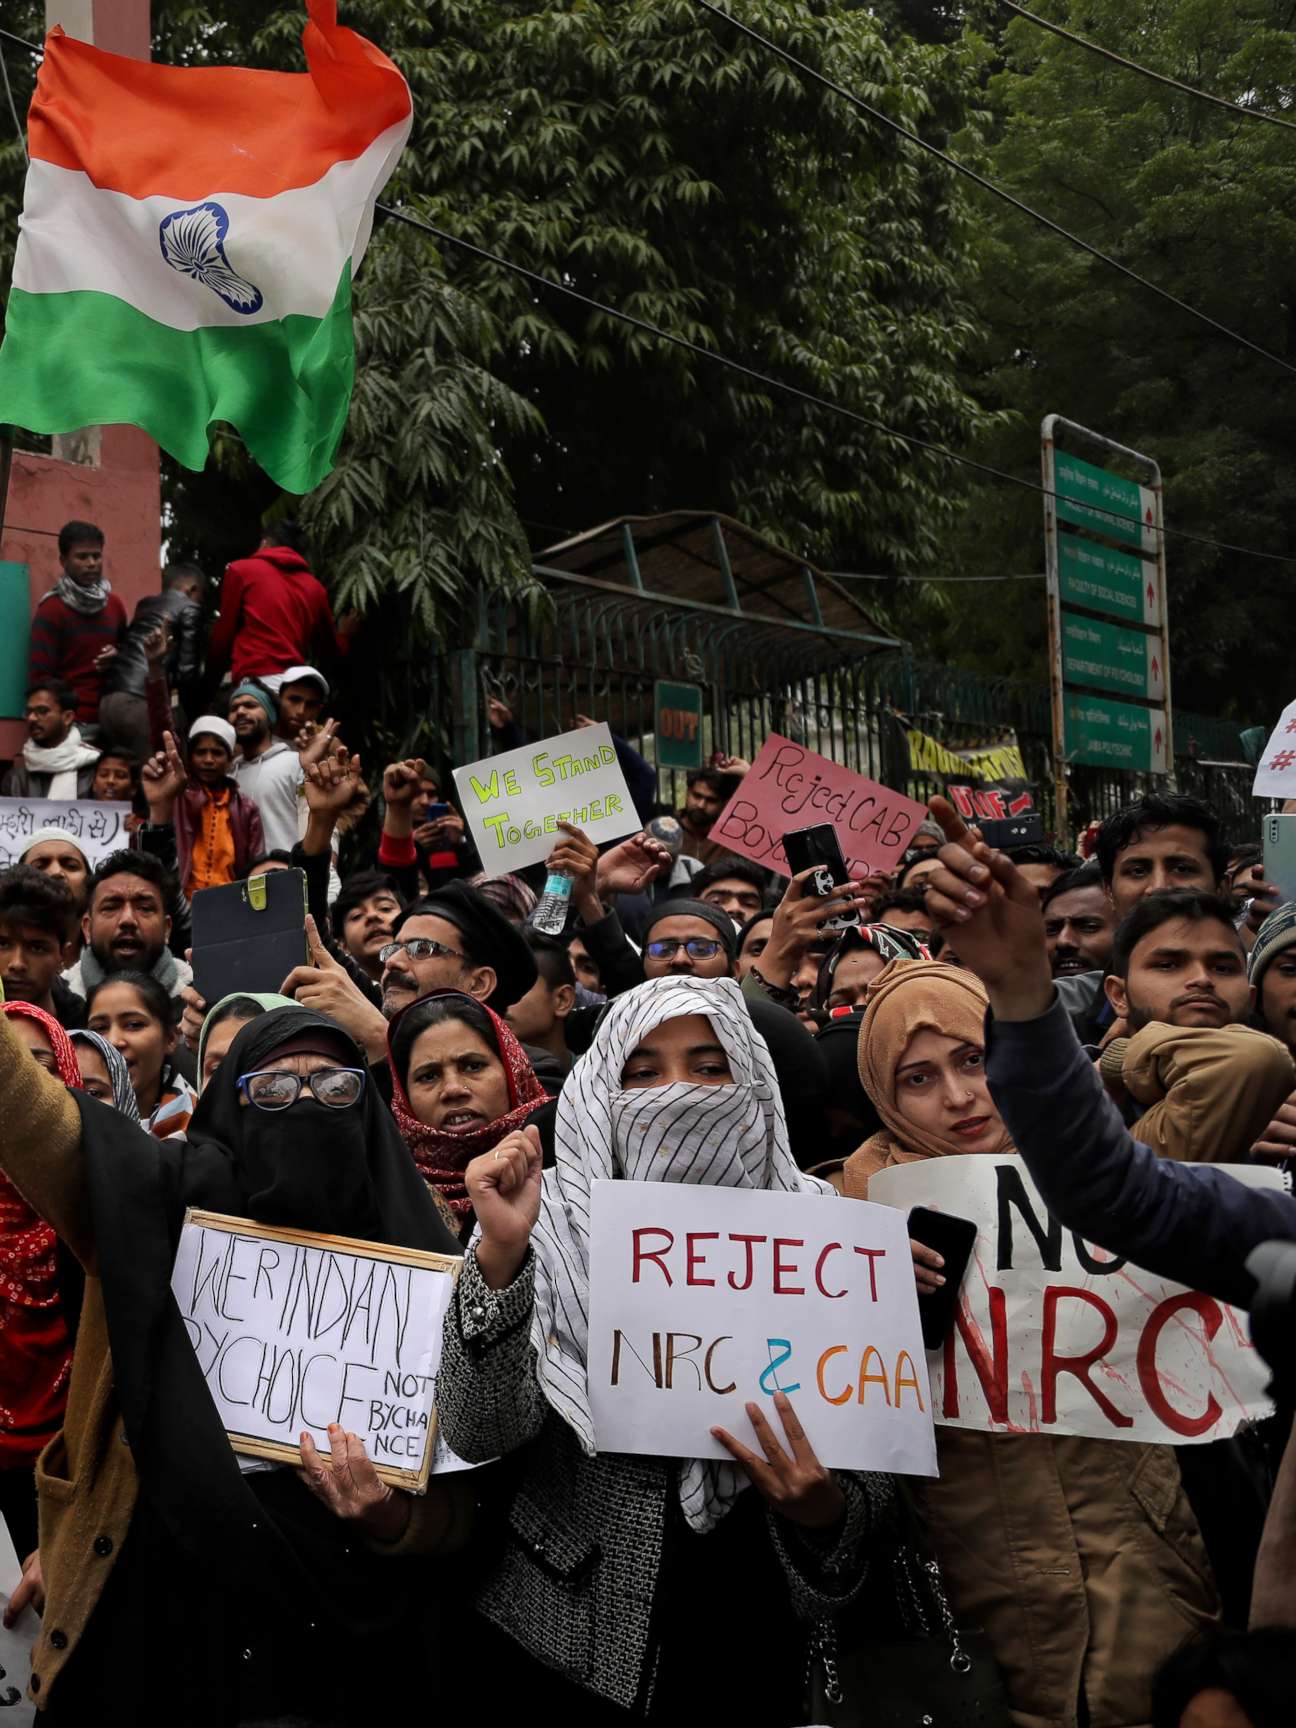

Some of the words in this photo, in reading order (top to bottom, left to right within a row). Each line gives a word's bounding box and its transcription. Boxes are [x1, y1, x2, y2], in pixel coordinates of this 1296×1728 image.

[660, 706, 699, 742] OUT
[469, 769, 522, 805] WE
[759, 745, 855, 814] Reject
[849, 797, 911, 847] CAB
[719, 800, 789, 862] Boyc
[632, 1227, 887, 1303] REJECT
[384, 1373, 438, 1399] NOT
[610, 1329, 737, 1395] NRC
[816, 1344, 926, 1414] CAA
[942, 1286, 1224, 1438] NRC
